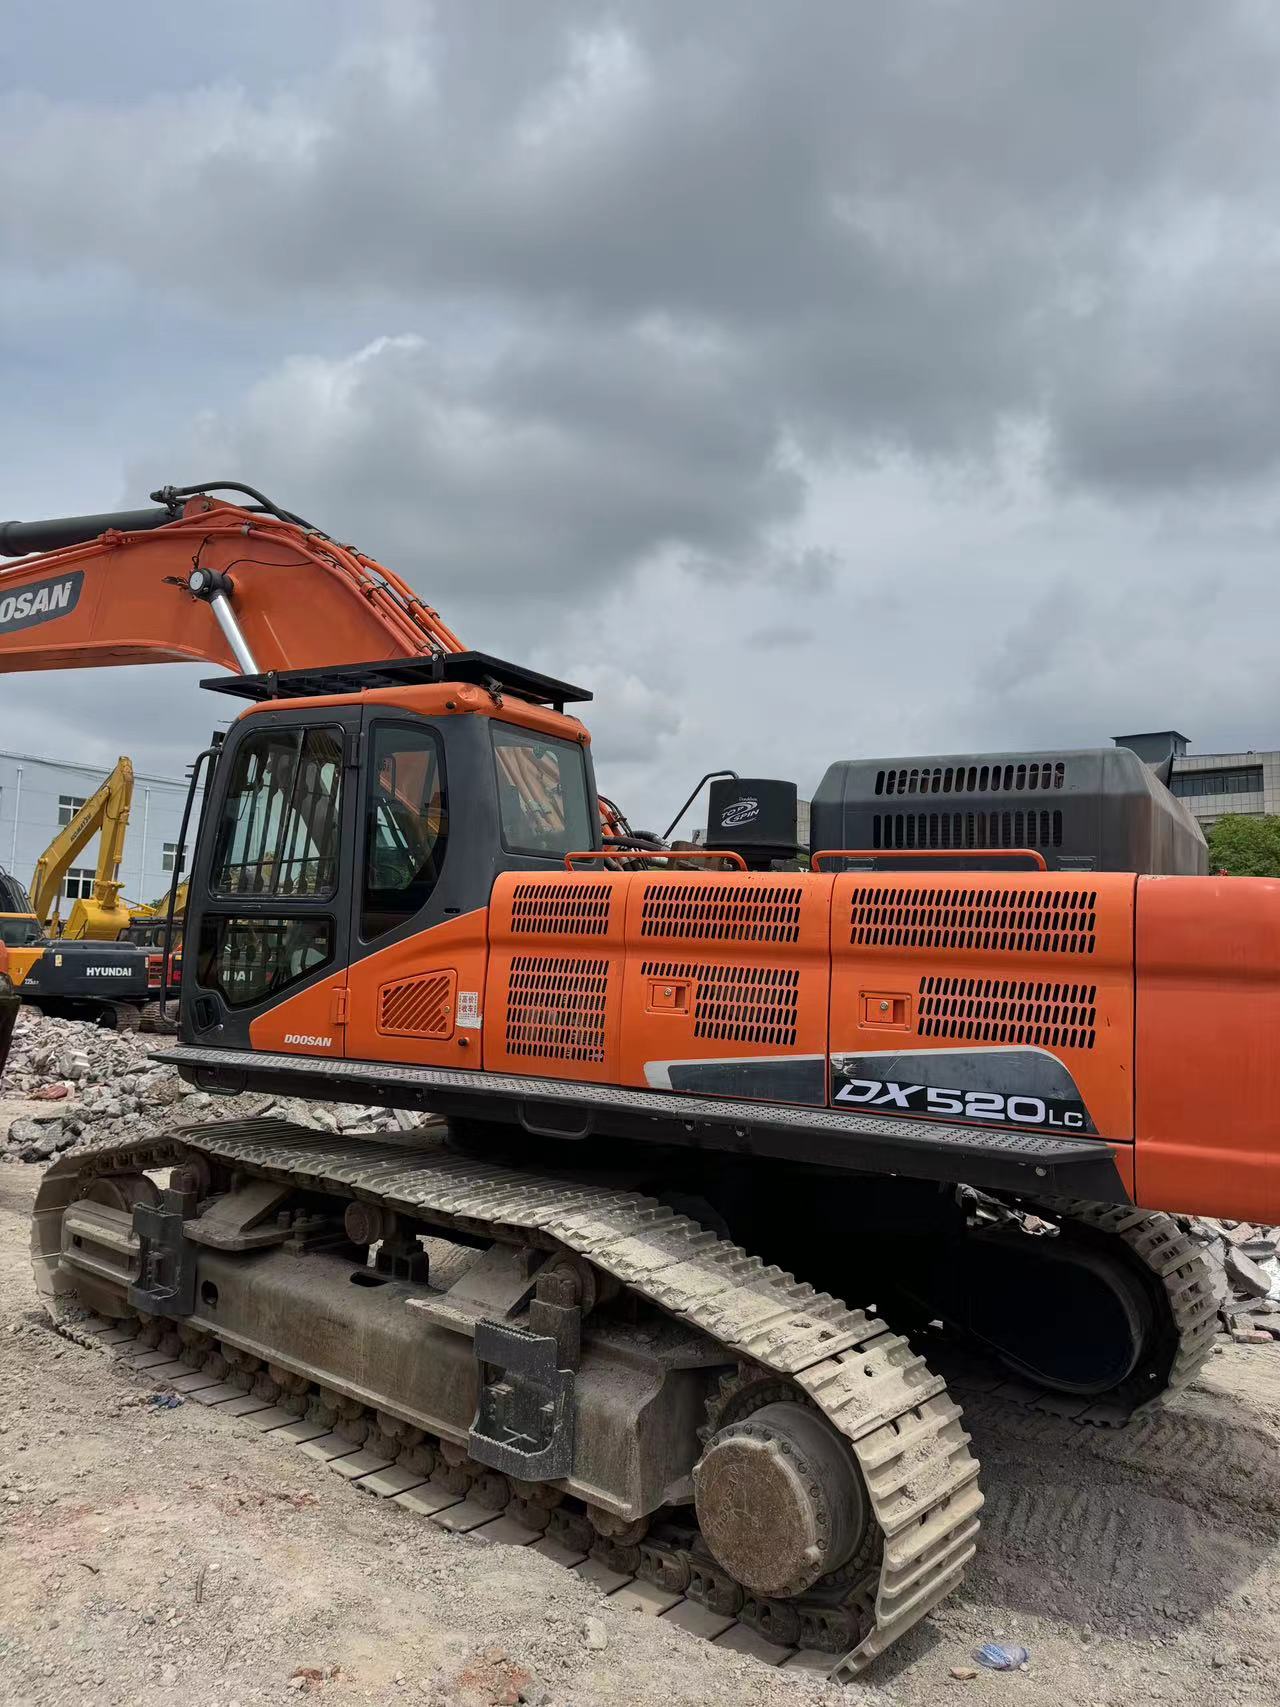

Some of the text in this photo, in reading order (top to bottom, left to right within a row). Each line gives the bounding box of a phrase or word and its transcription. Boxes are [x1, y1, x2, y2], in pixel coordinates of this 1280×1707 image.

[722, 806, 744, 819] TOP
[733, 808, 760, 821] SPIN
[86, 967, 132, 977] HYUNDAI
[284, 1034, 332, 1047] DOOSAN
